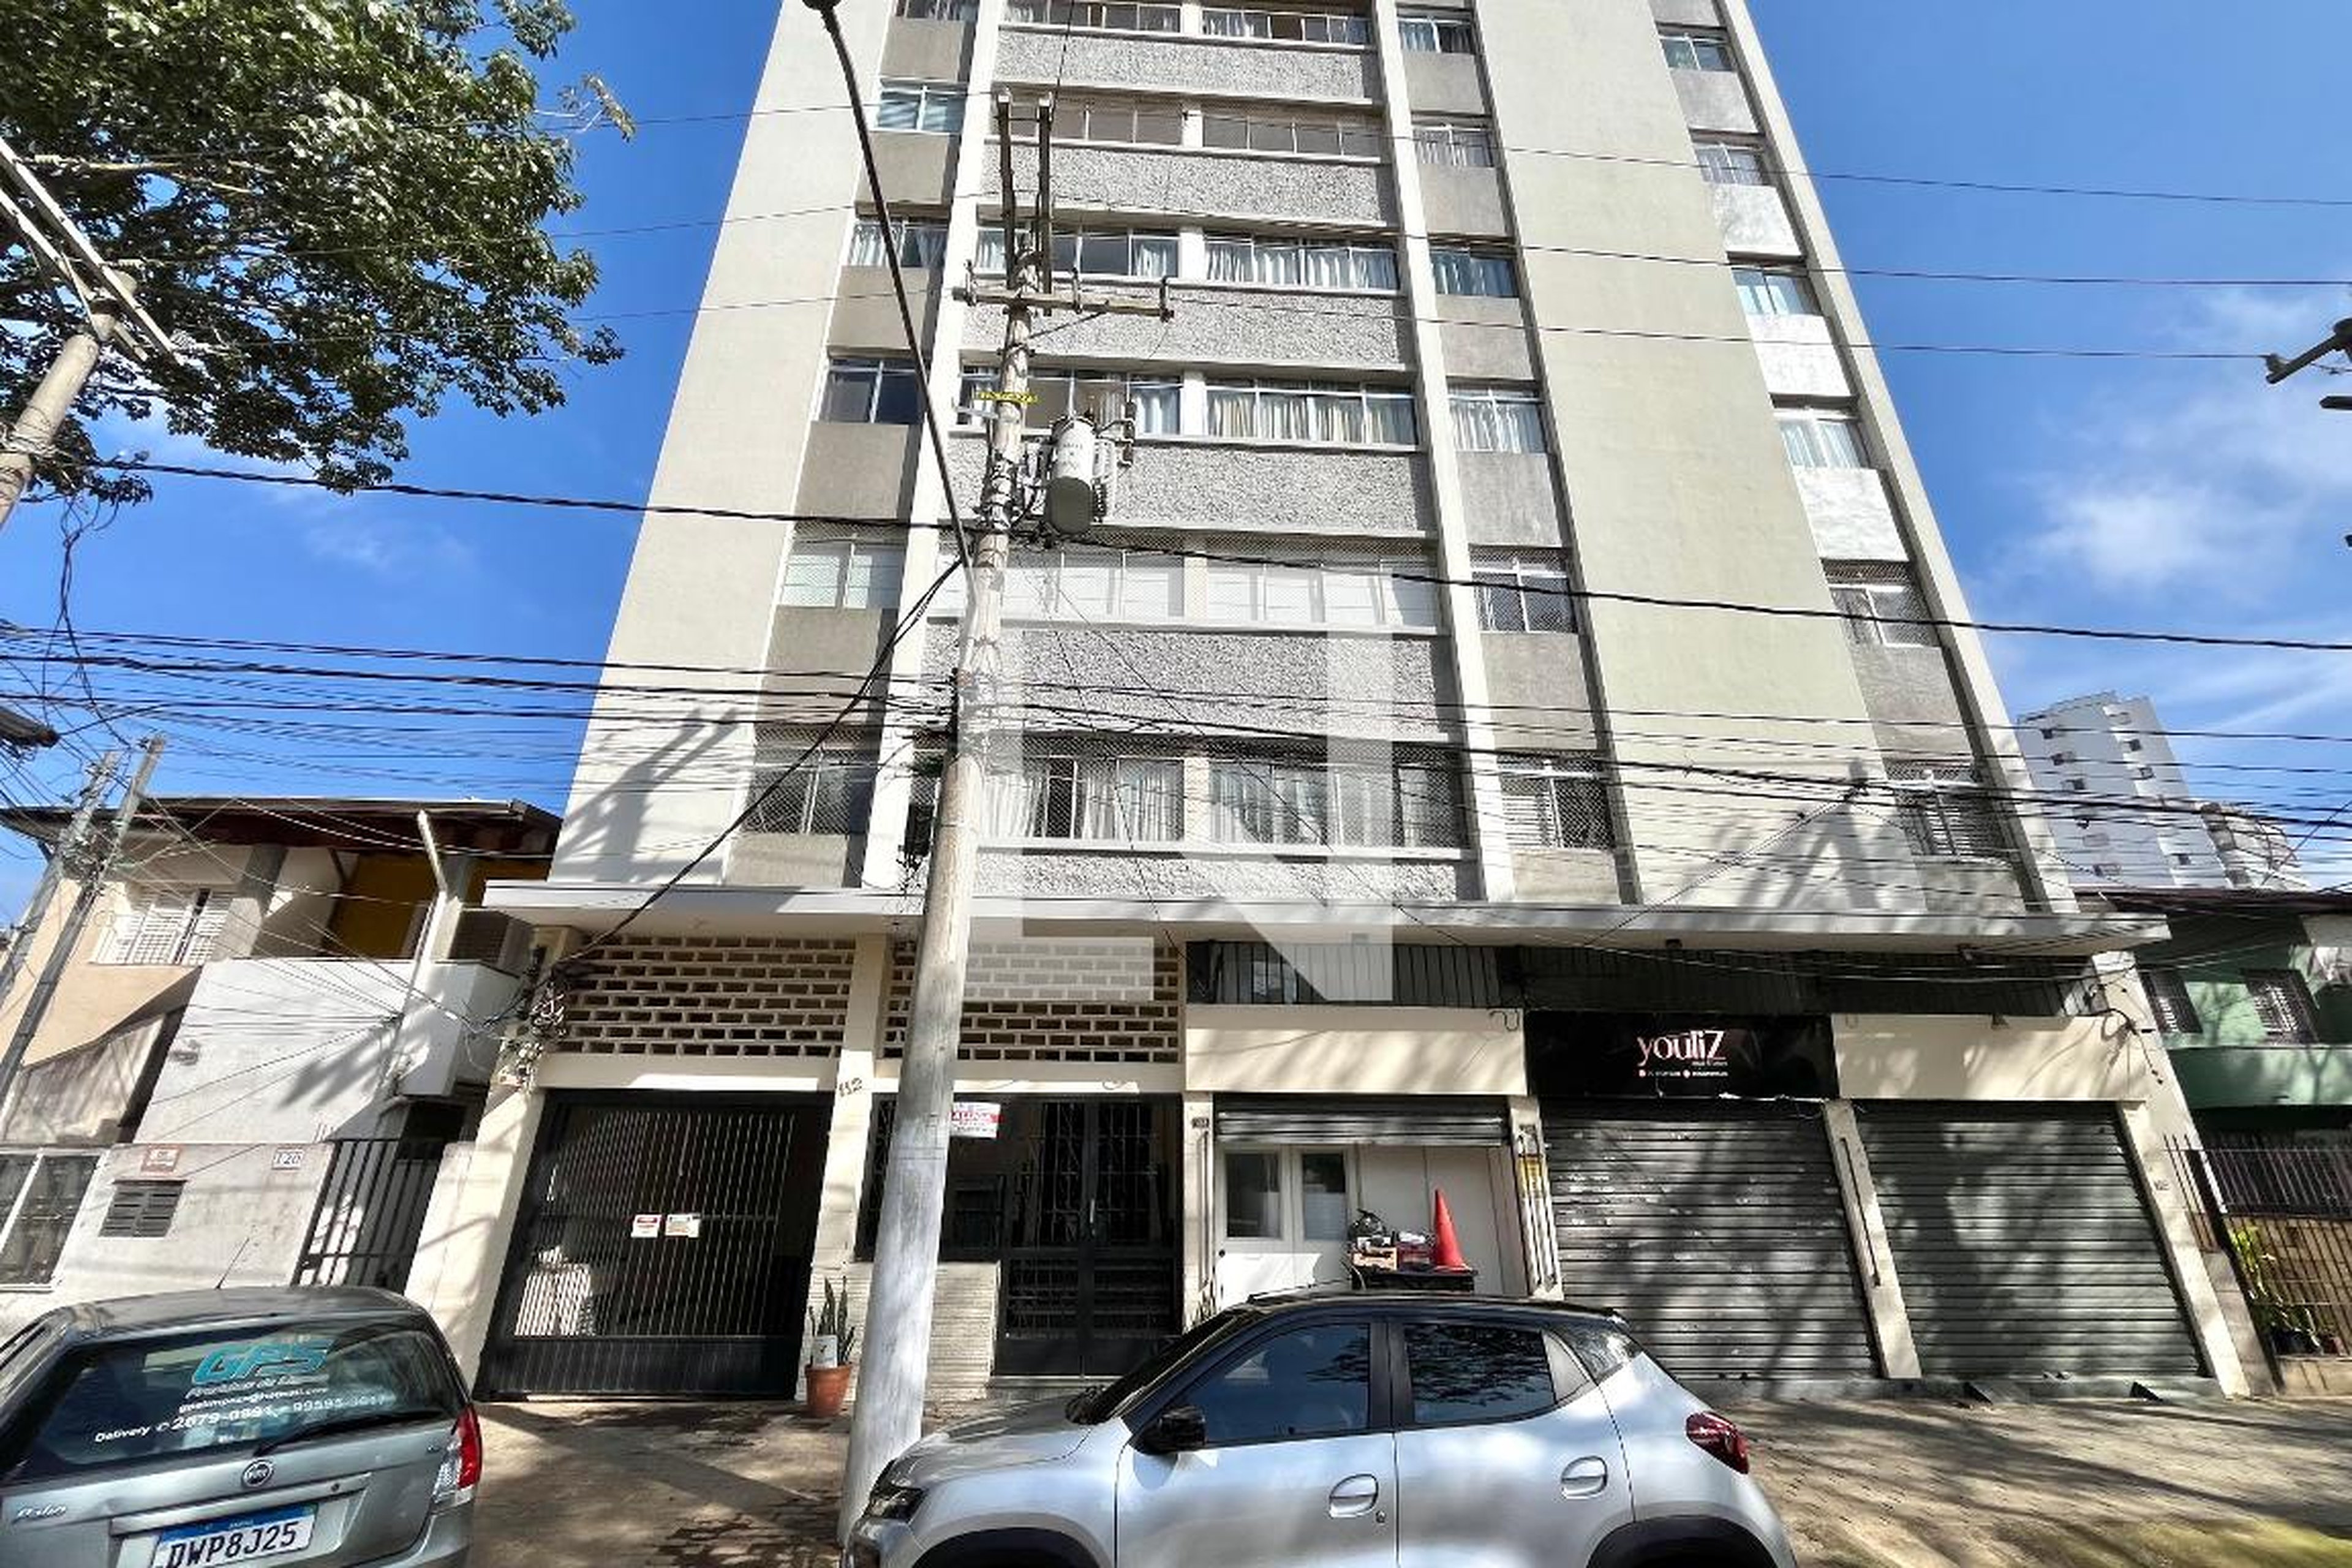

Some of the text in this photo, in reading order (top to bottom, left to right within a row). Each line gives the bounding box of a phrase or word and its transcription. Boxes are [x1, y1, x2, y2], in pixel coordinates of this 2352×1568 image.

[839, 1077, 863, 1098] 112
[94, 1425, 151, 1443] Delivery
[165, 1520, 300, 1568] DWP8J25
